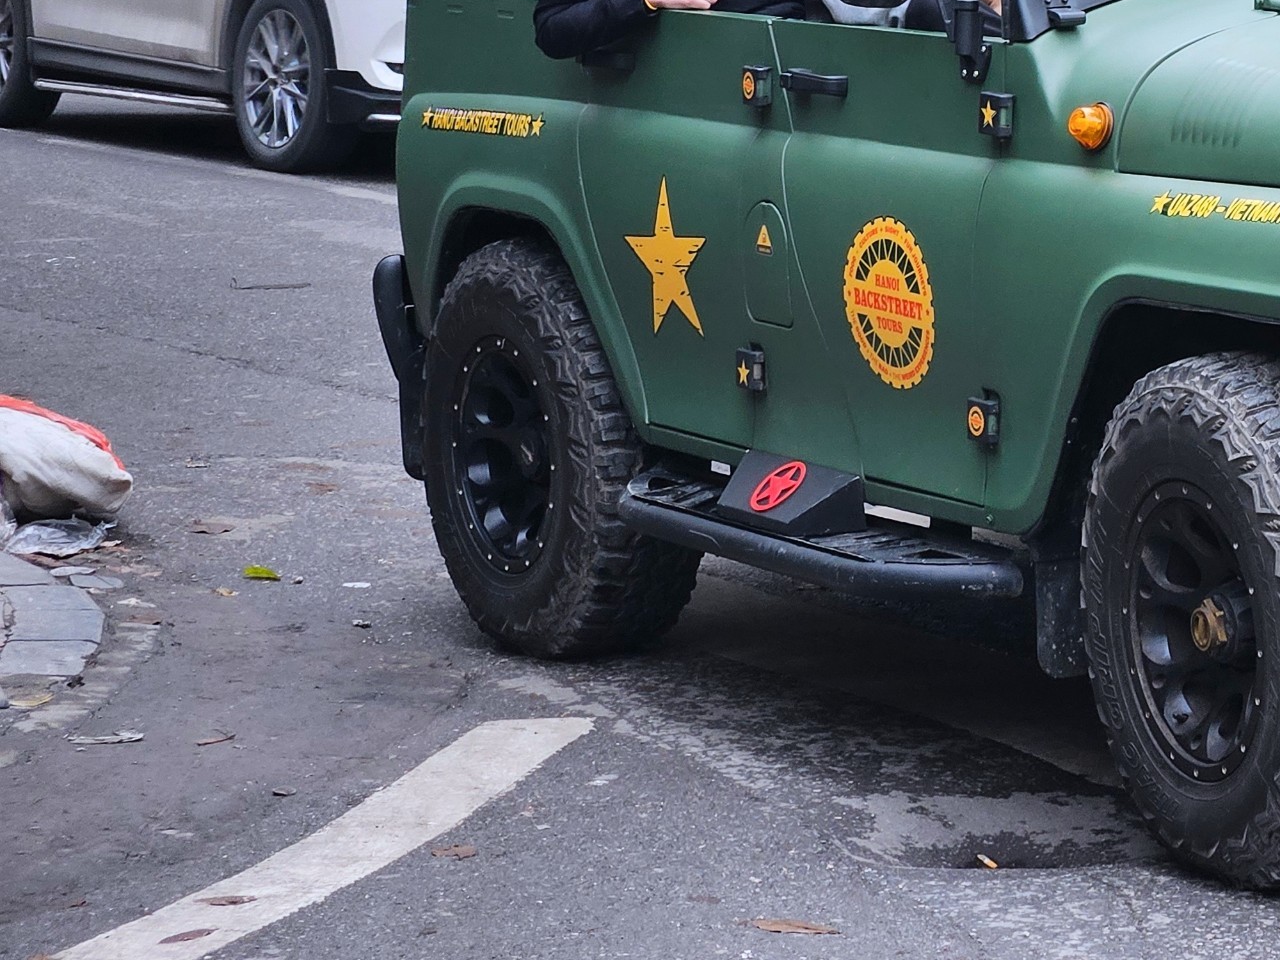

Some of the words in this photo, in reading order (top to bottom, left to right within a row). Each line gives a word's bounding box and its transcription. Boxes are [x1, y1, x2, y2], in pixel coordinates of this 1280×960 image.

[432, 107, 455, 129] HANOI
[454, 109, 506, 135] BACKSTREET
[503, 113, 531, 137] TOURS
[1167, 193, 1221, 218] UAZ469
[1224, 198, 1280, 224] VIETNAM
[874, 273, 900, 292] HANOI
[853, 286, 923, 321] BACKSTREET
[876, 315, 903, 335] TOURS
